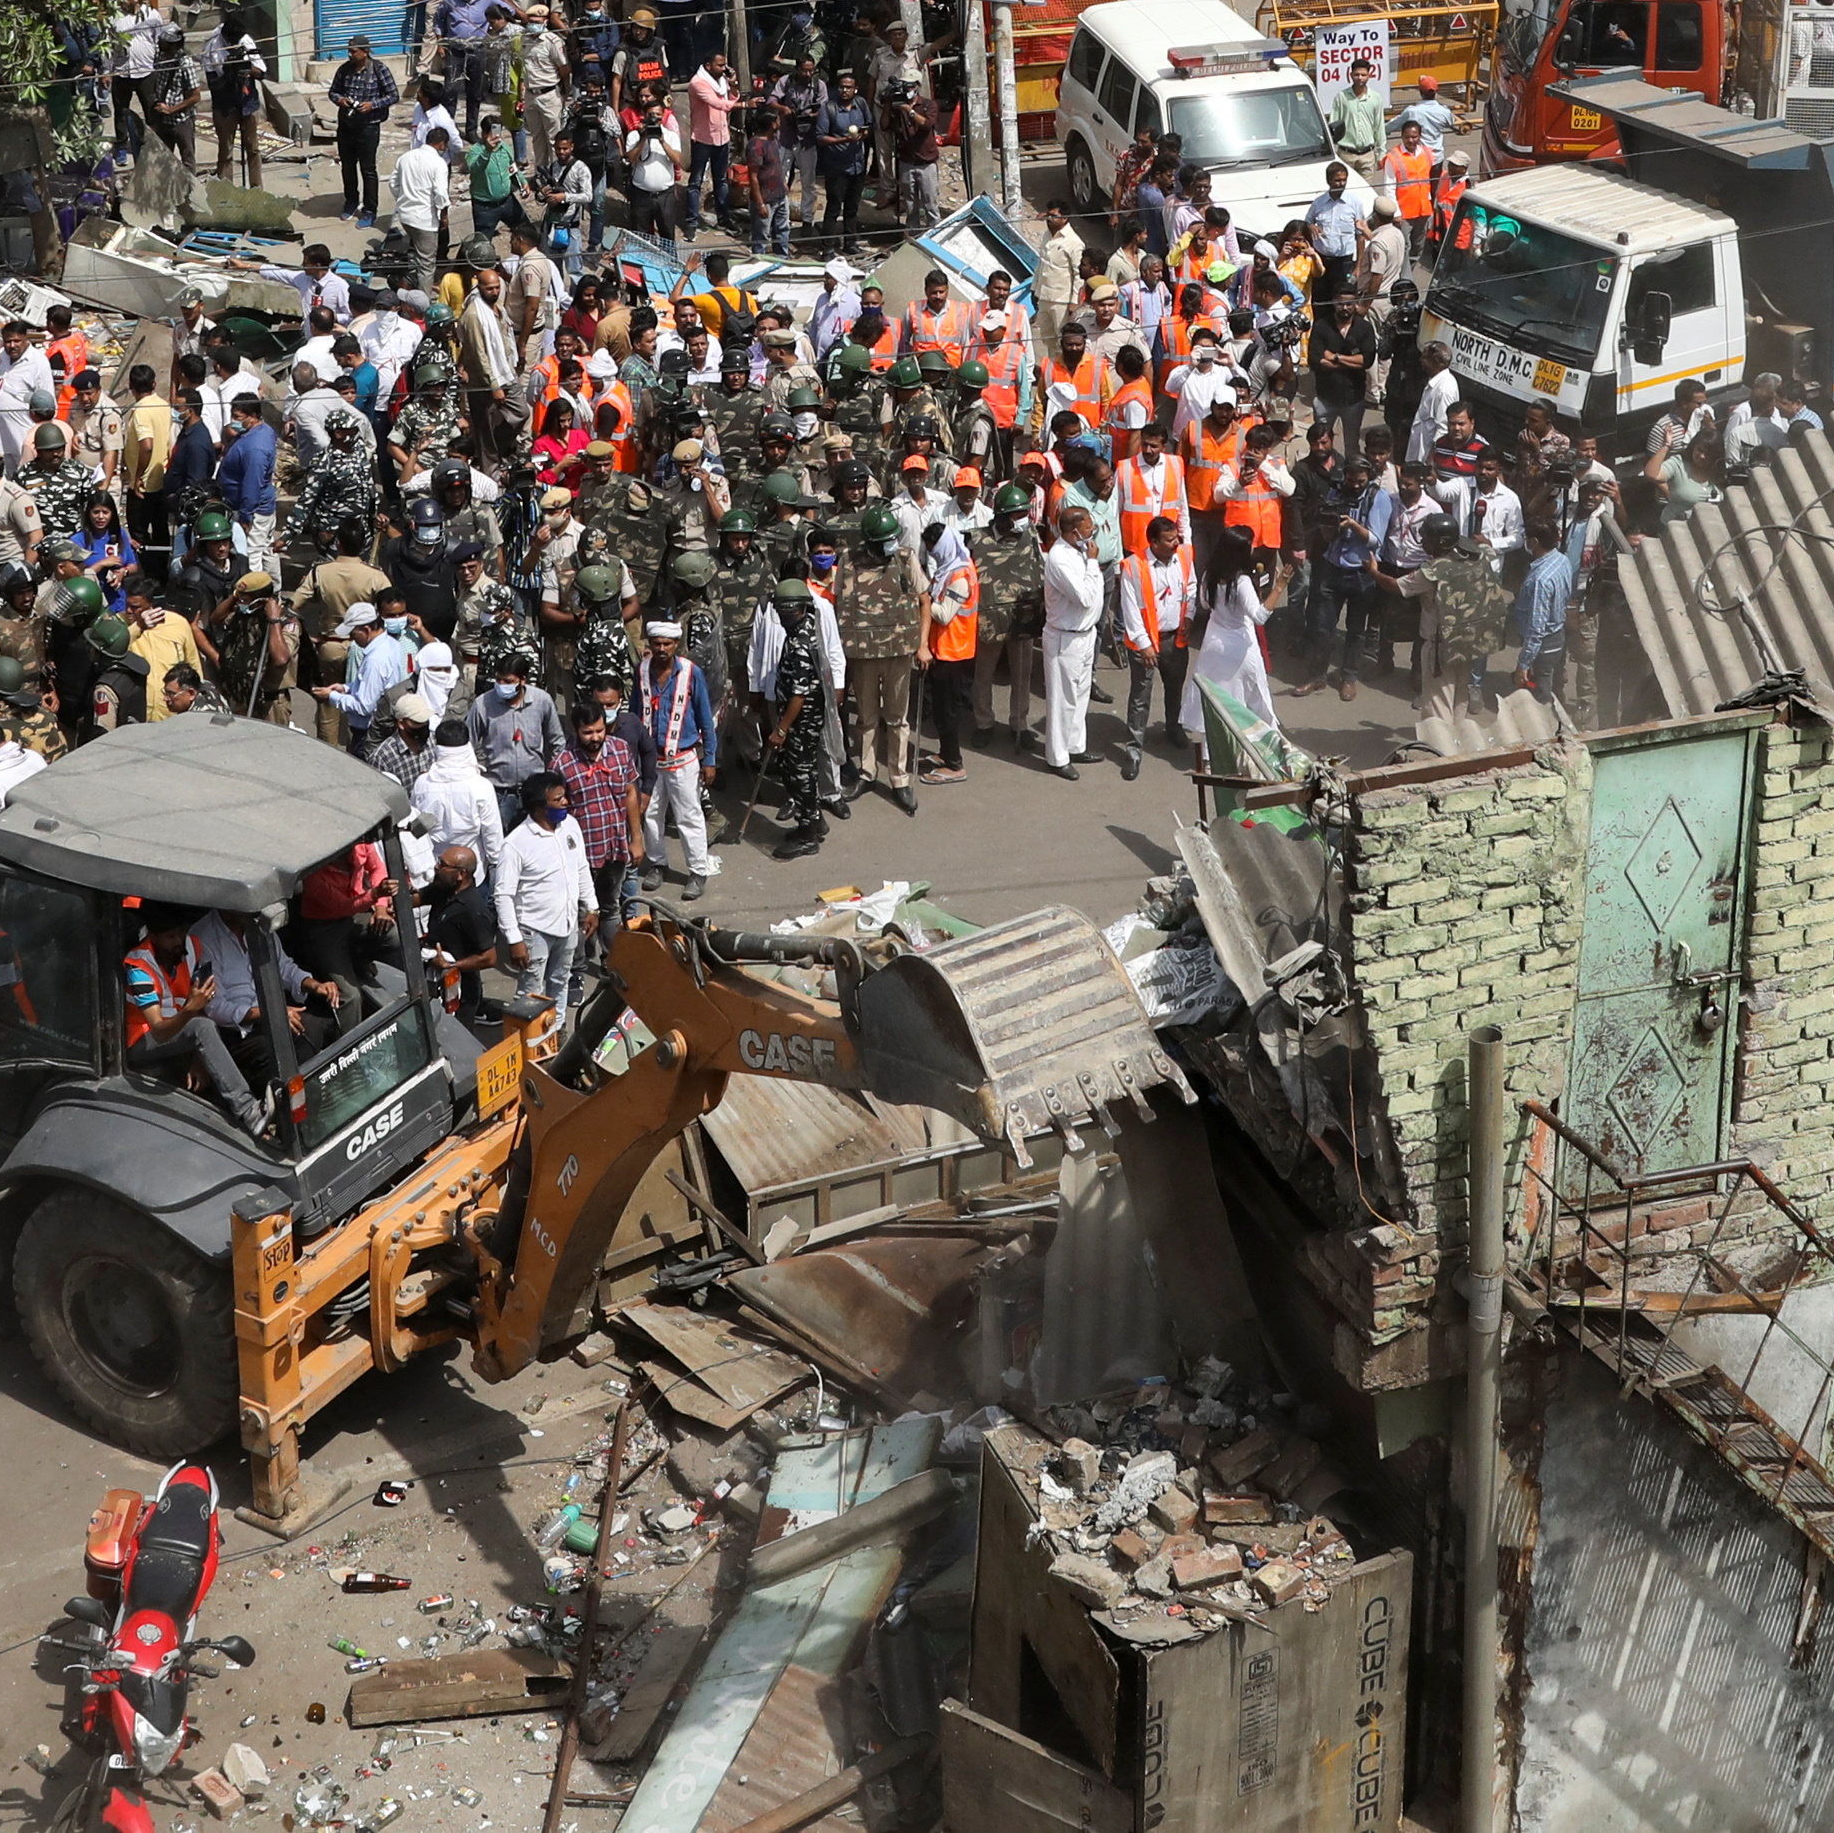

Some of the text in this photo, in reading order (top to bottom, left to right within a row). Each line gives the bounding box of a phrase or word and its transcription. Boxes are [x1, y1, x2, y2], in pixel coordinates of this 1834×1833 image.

[1323, 29, 1379, 46] Way To
[1320, 45, 1383, 65] SECTOR
[638, 69, 663, 80] POLICE
[1321, 68, 1340, 83] 04
[1574, 118, 1598, 128] 0201
[1452, 331, 1491, 362] NORTH
[1496, 350, 1533, 380] D.M.C.
[1456, 353, 1471, 369] CIVIL
[1474, 361, 1490, 376] LINE
[1493, 369, 1514, 386] ZONE
[1538, 360, 1561, 377] DL1G
[1532, 376, 1560, 396] C7622
[738, 1029, 836, 1074] CASE
[488, 1068, 498, 1083] DL
[346, 1101, 404, 1161] CASE
[557, 1153, 579, 1197] 770
[1359, 1596, 1388, 1696] CUBE
[1355, 1728, 1381, 1828] CUBE
